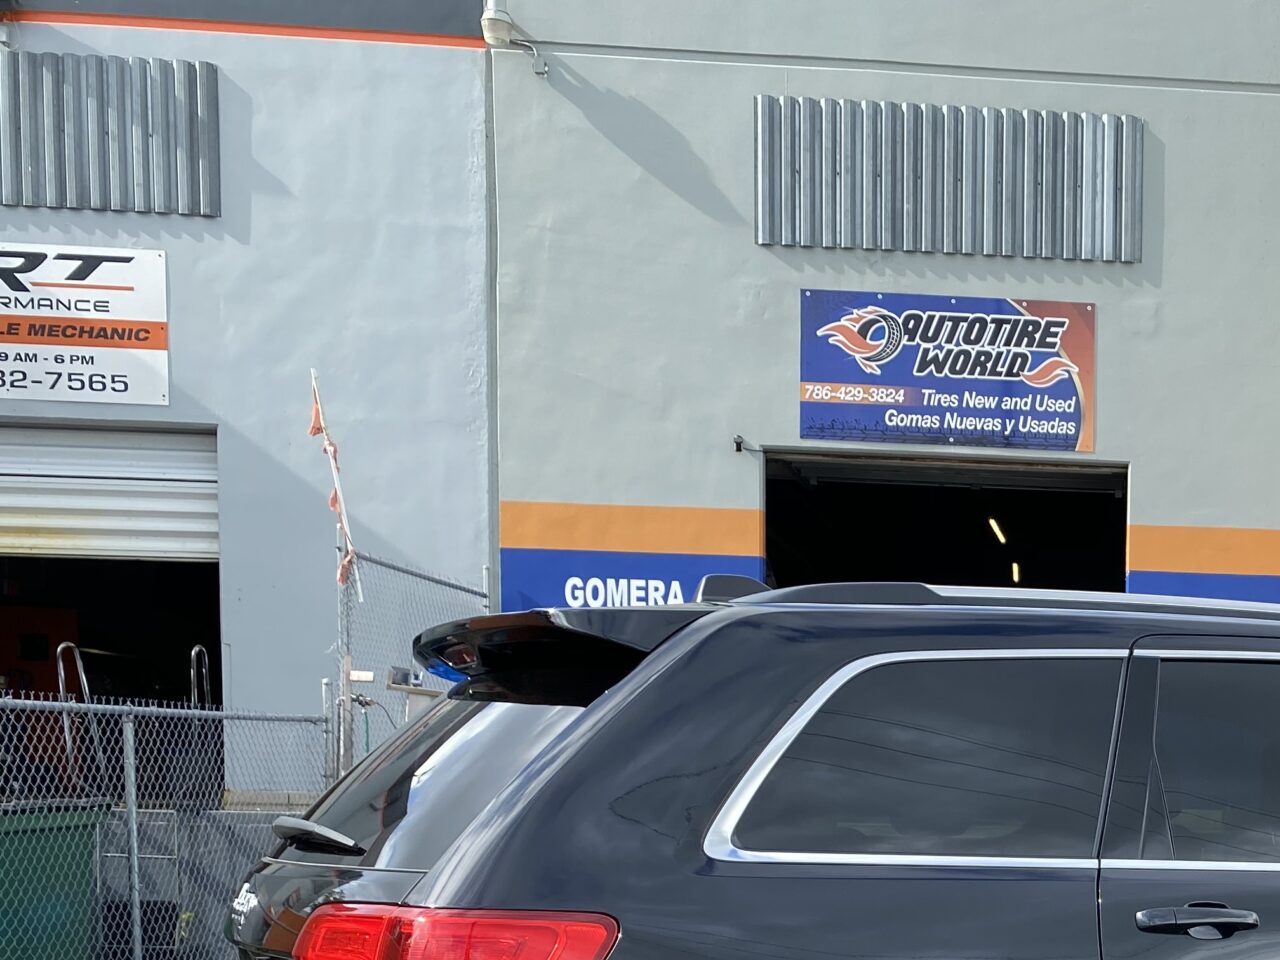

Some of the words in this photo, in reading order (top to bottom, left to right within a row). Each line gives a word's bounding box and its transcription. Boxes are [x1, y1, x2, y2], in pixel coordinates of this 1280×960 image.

[27, 323, 151, 343] MECHANIC
[901, 311, 1068, 351] AUTOTIRE
[13, 352, 38, 363] AM
[53, 353, 65, 365] 6
[69, 354, 95, 366] PM
[914, 348, 1030, 379] WORLD
[804, 384, 905, 403] 786-429-3824
[921, 388, 959, 407] Tires
[962, 390, 998, 409] New
[1001, 393, 1033, 411] and
[1035, 394, 1077, 413] Used
[884, 408, 940, 428] Gomas
[943, 411, 1002, 431] Nuevas
[1004, 418, 1015, 435] y
[1018, 415, 1077, 434] Usadas
[564, 576, 685, 608] GOMERA
